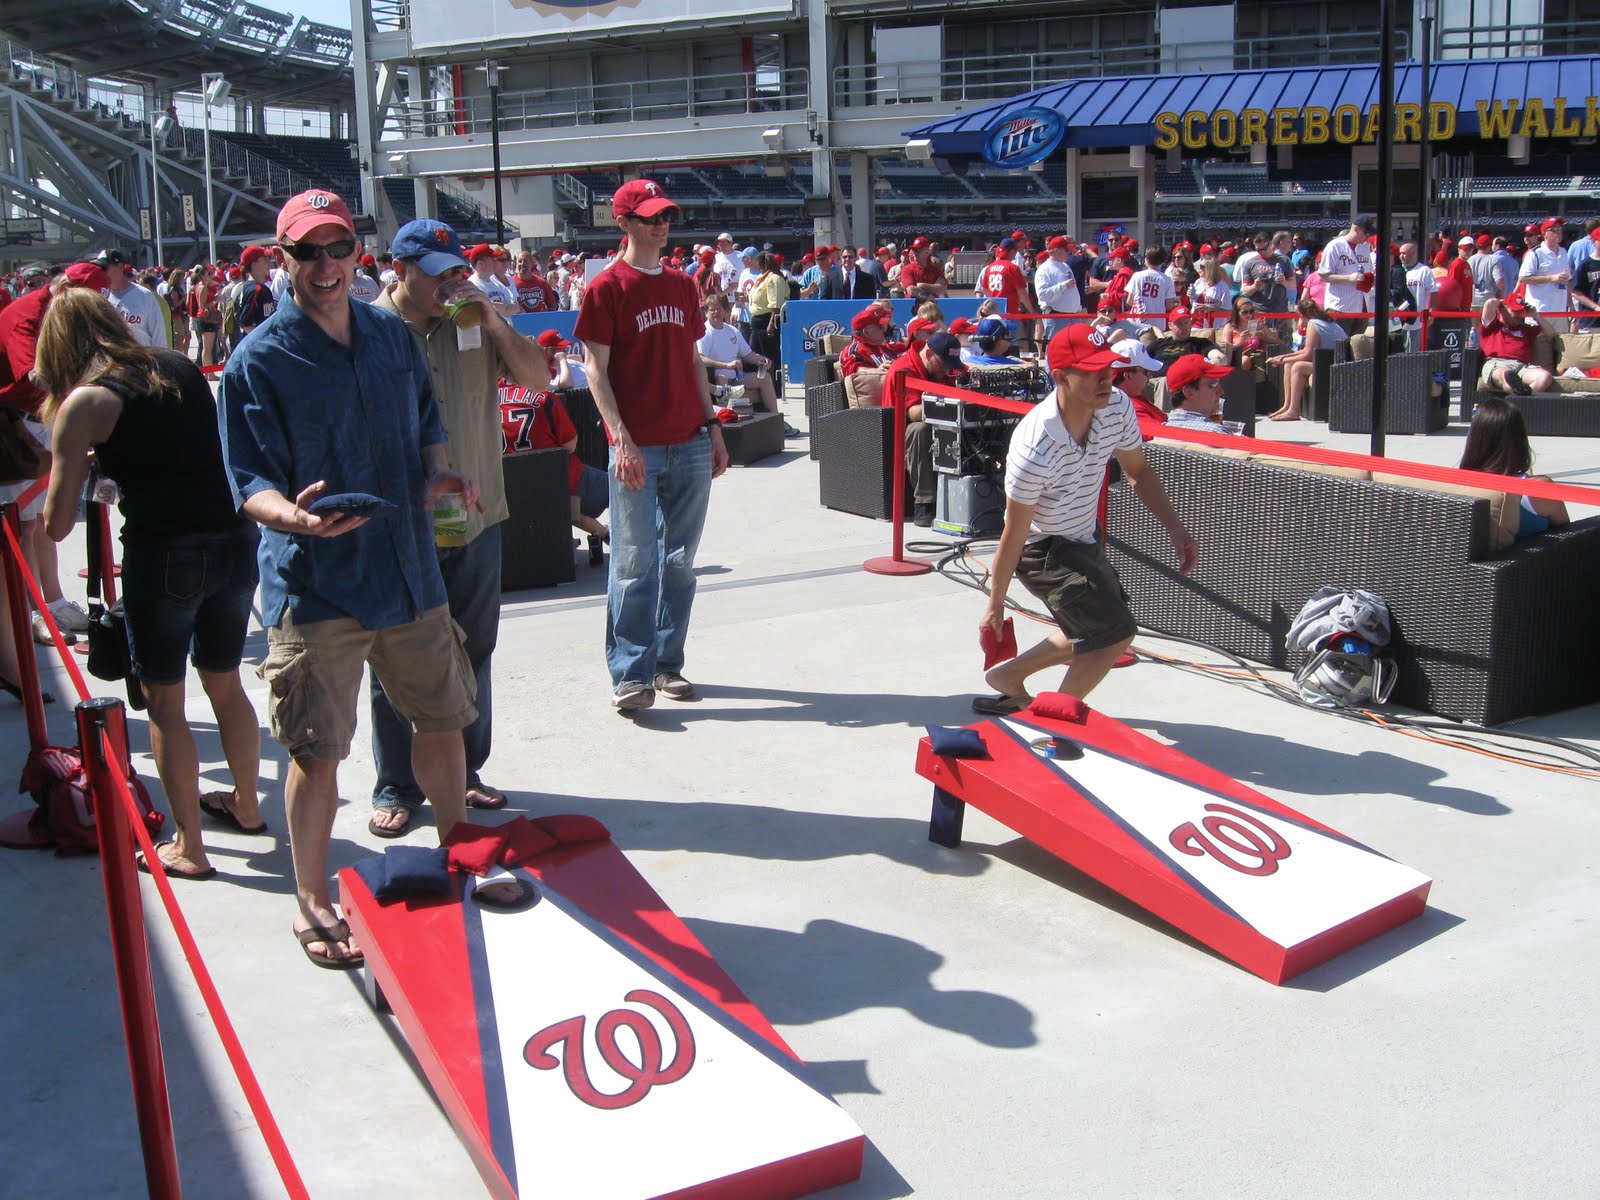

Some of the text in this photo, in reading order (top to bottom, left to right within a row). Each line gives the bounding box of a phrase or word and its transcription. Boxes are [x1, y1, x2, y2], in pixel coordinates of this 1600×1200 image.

[1003, 117, 1039, 134] Miller
[1154, 101, 1457, 150] SCOREBOARD
[998, 123, 1049, 160] Lite
[185, 198, 193, 228] 239
[1141, 282, 1160, 298] 26
[635, 305, 685, 333] DELAWARE
[523, 989, 696, 1110] W
